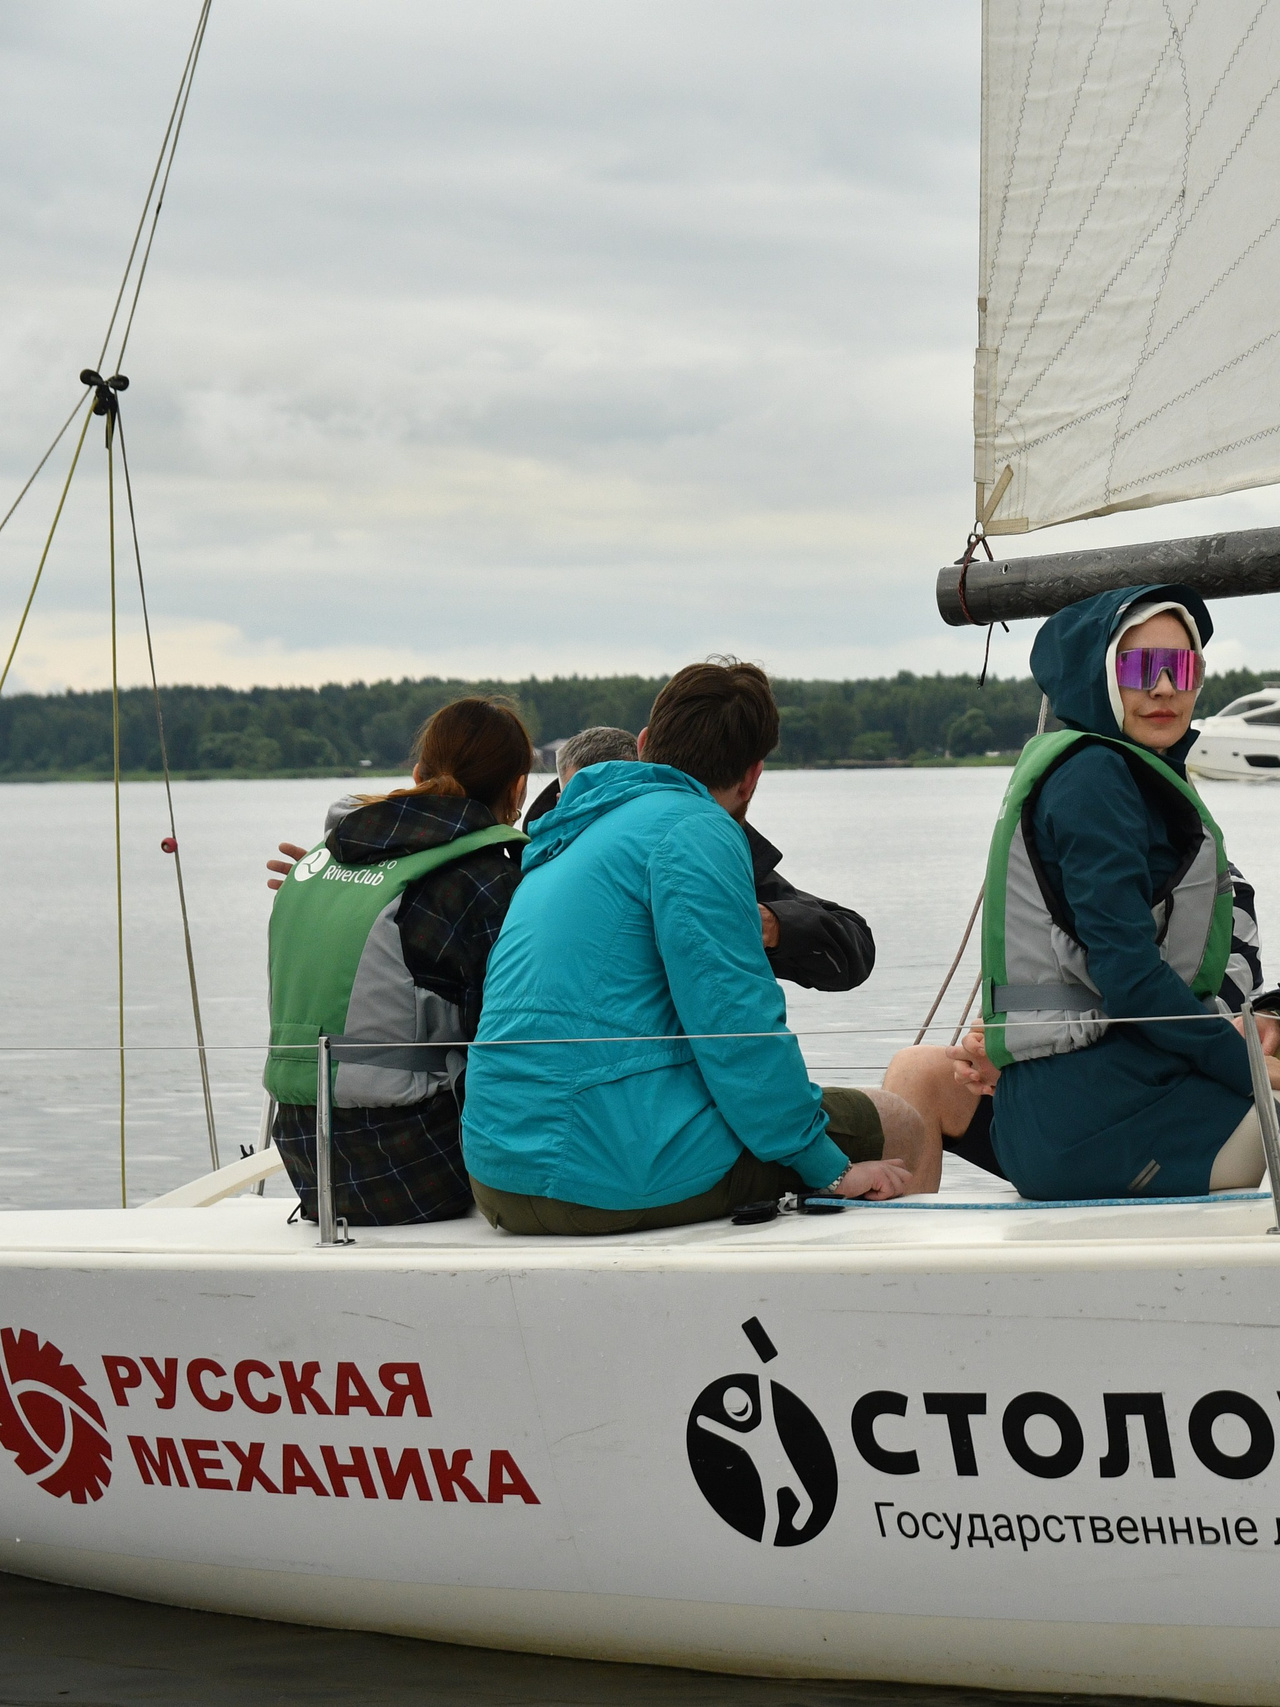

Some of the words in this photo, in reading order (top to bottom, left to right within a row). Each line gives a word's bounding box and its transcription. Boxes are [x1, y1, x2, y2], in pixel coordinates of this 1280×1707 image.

[322, 865, 385, 886] RiverClub
[101, 1355, 433, 1418] РУССКАЯ
[126, 1435, 541, 1505] МЕХАНИКА
[873, 1501, 1259, 1552] Государственные
